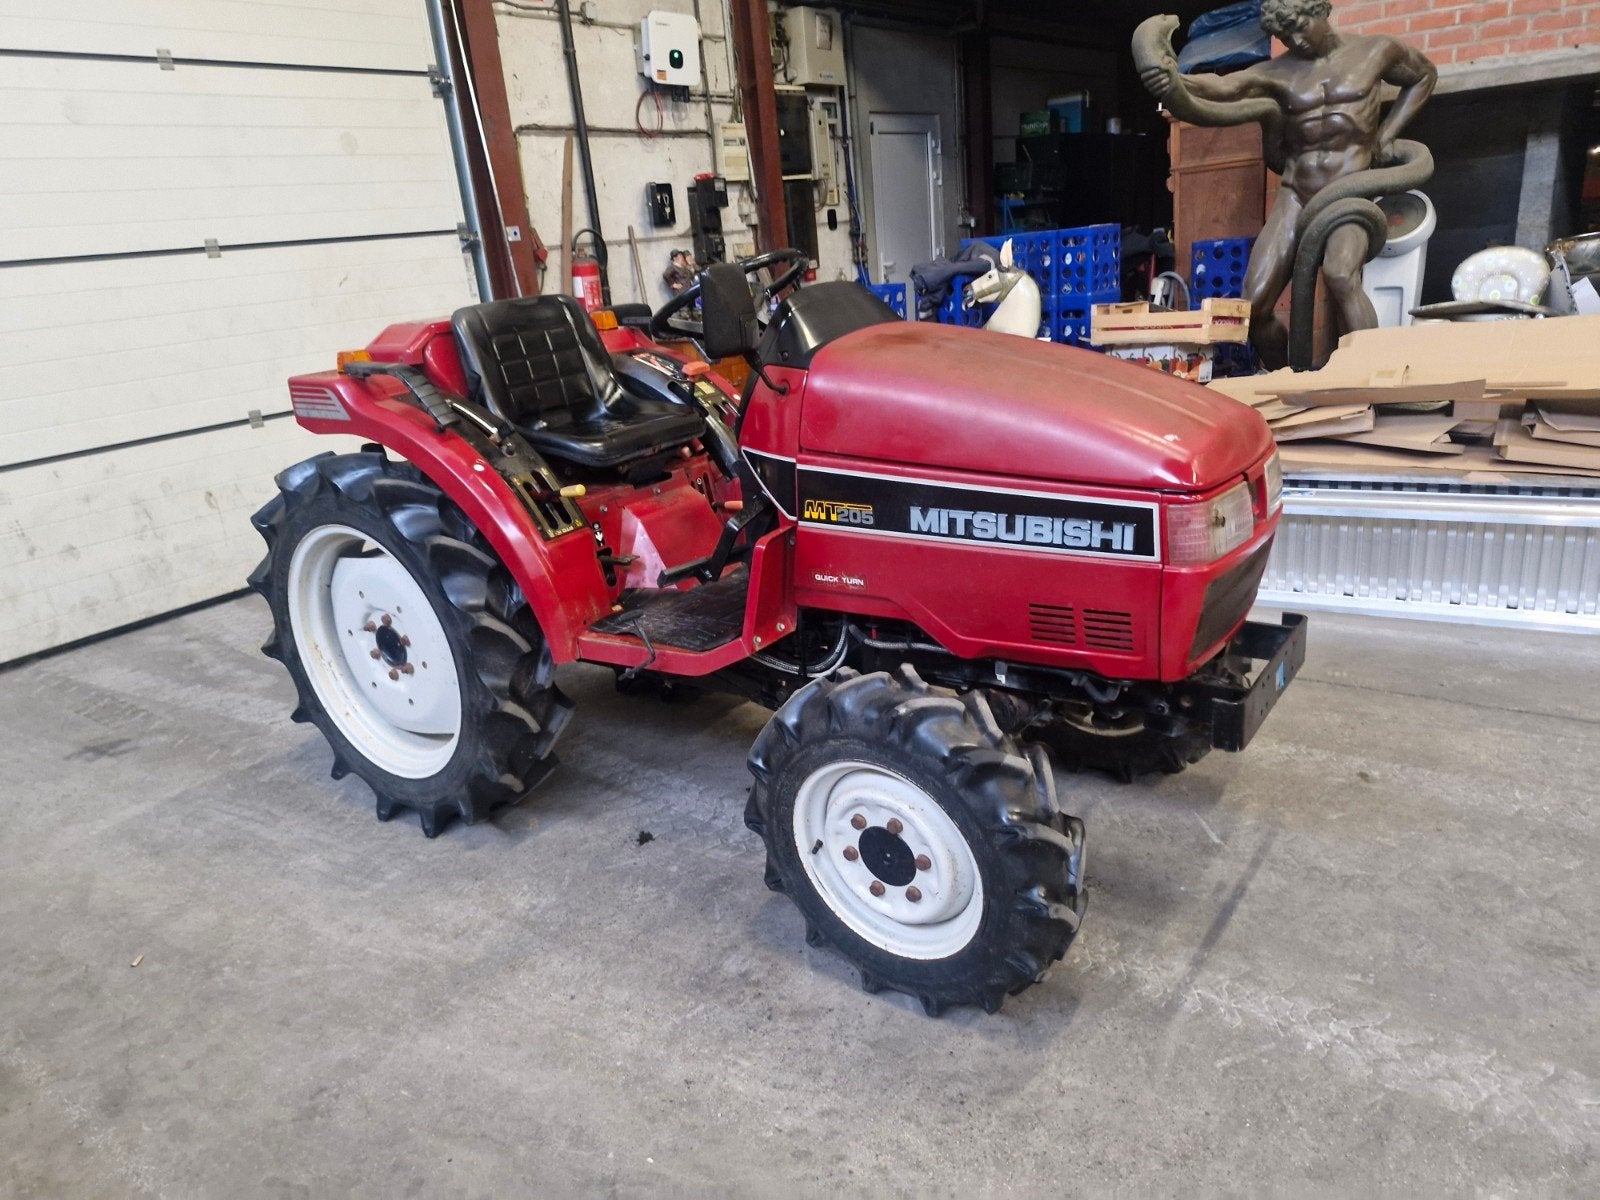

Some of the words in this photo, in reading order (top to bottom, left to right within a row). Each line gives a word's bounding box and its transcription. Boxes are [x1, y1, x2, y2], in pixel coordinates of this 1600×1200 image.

[908, 506, 1137, 551] MITSUBISHI
[814, 573, 839, 583] QUICK
[841, 576, 865, 586] TURN
